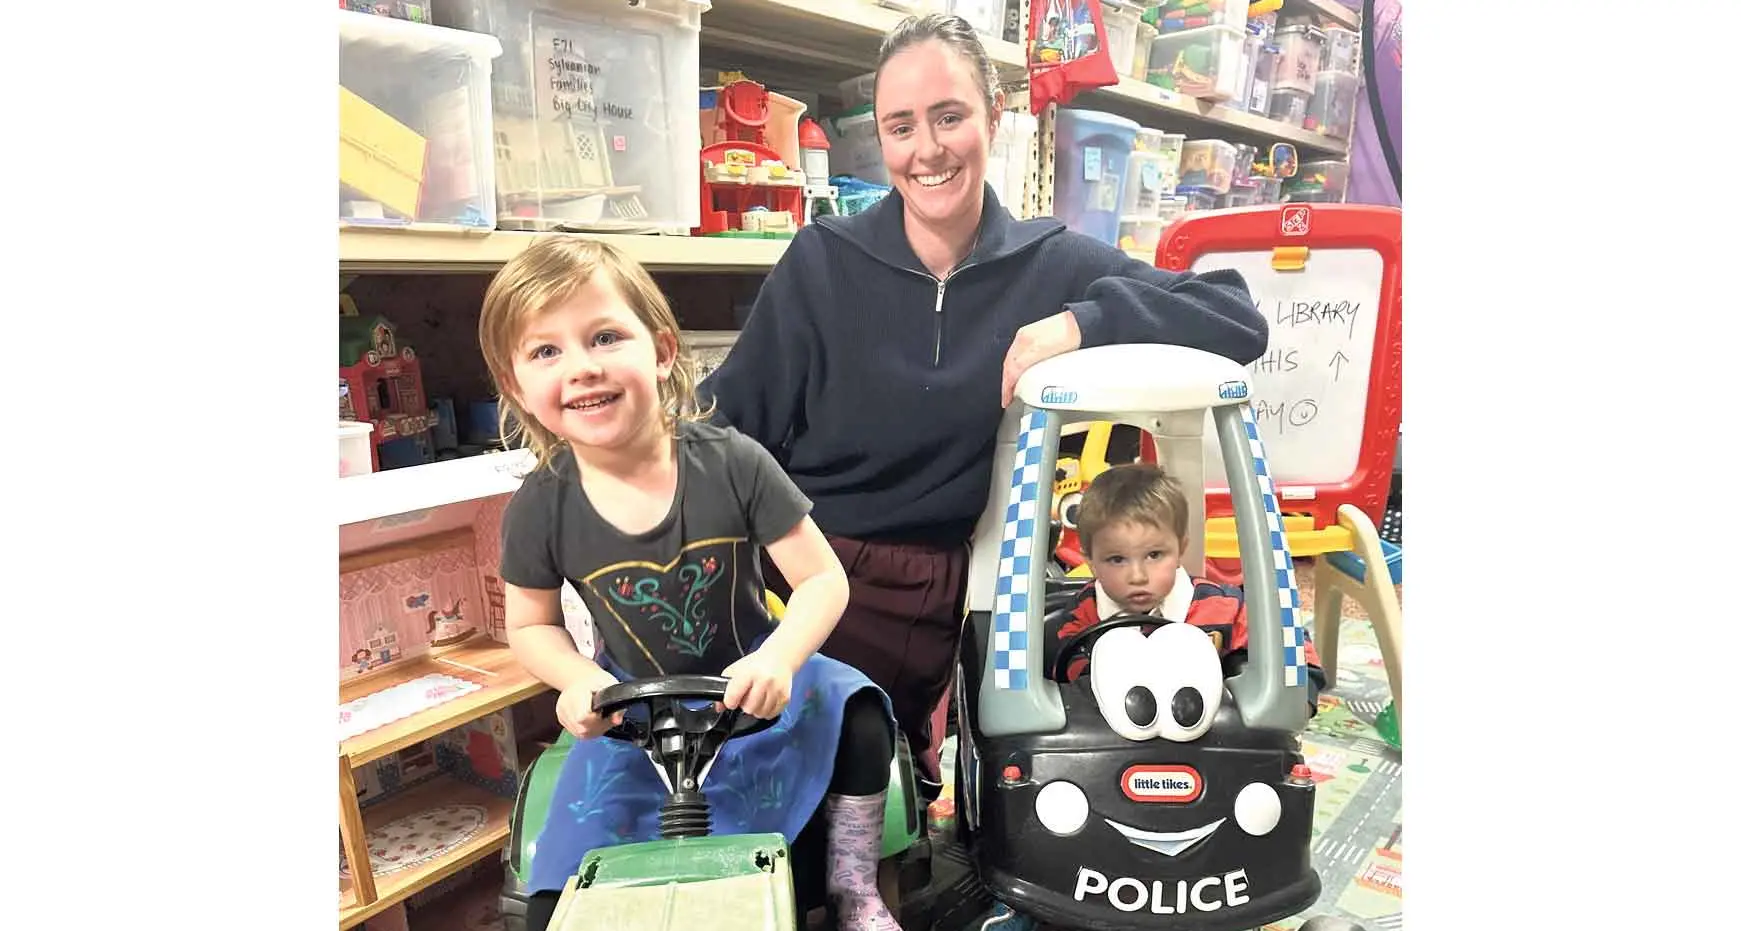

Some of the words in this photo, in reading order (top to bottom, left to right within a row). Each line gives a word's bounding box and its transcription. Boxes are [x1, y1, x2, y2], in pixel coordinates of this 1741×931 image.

[548, 58, 601, 76] Sylvanian
[550, 77, 593, 93] Families
[1277, 300, 1360, 340] LIBRARY
[1134, 778, 1160, 789] little
[1162, 778, 1189, 789] tikes
[1073, 866, 1250, 914] POLICE
